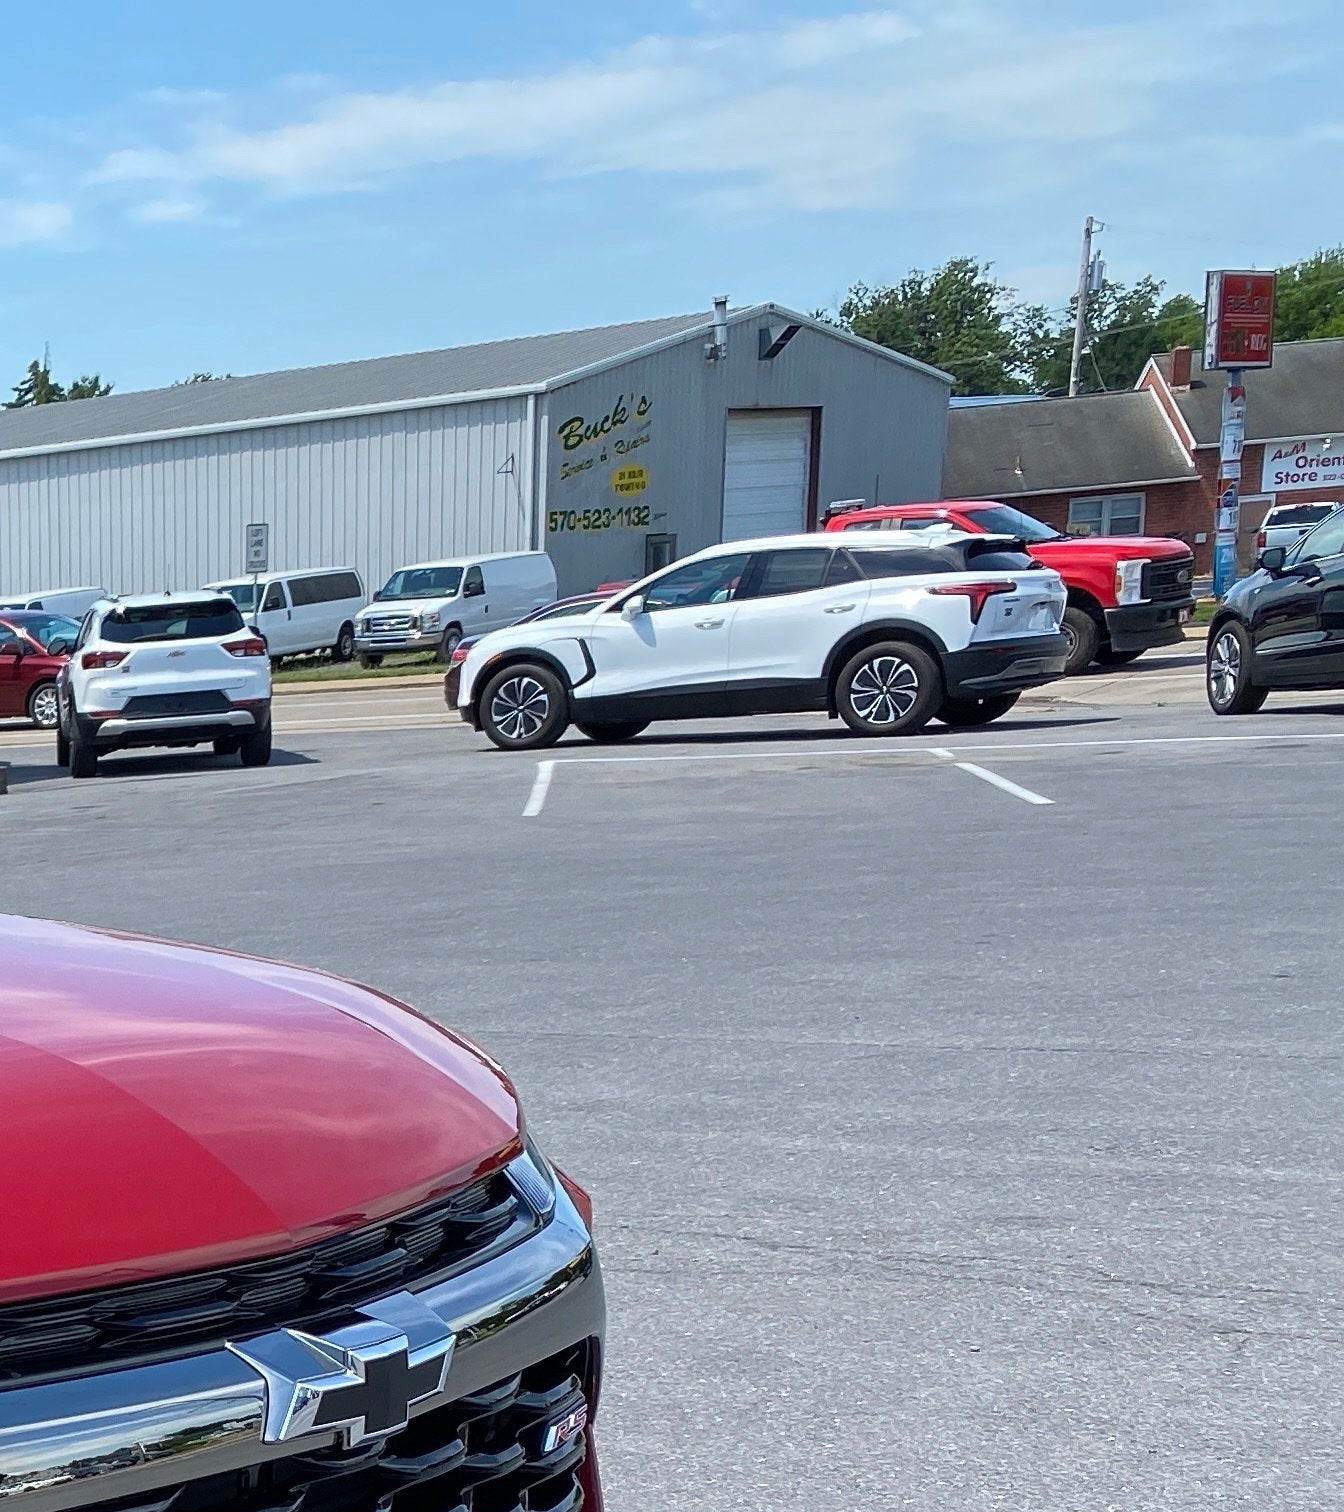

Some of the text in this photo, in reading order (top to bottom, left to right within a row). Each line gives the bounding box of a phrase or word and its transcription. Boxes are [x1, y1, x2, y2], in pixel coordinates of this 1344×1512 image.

[558, 392, 653, 451] Buck's
[1274, 471, 1318, 485] Store
[549, 505, 650, 532] 570-523-1132
[546, 1403, 588, 1451] RS
